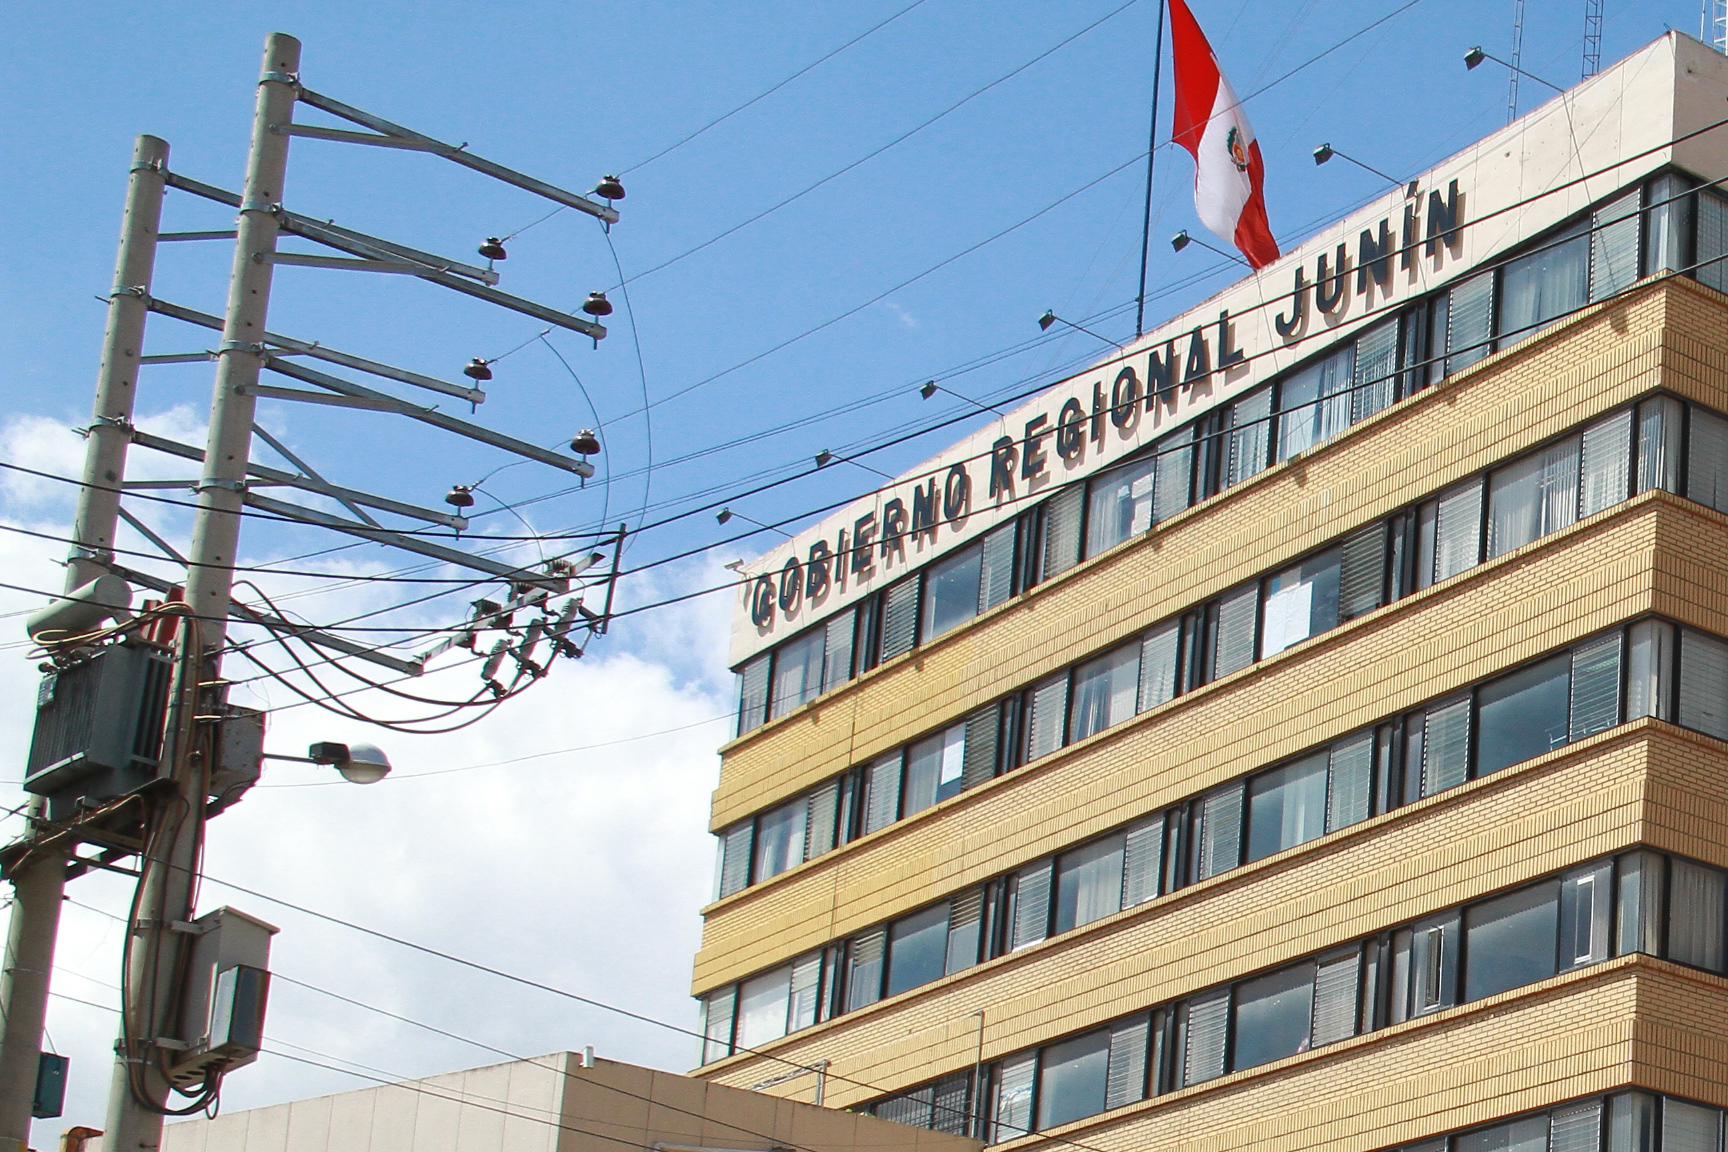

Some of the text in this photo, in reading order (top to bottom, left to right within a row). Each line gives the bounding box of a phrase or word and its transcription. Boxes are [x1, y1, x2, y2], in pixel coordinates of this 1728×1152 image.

[752, 178, 1459, 626] GOBIERNO REGIONAL JUNÍN
